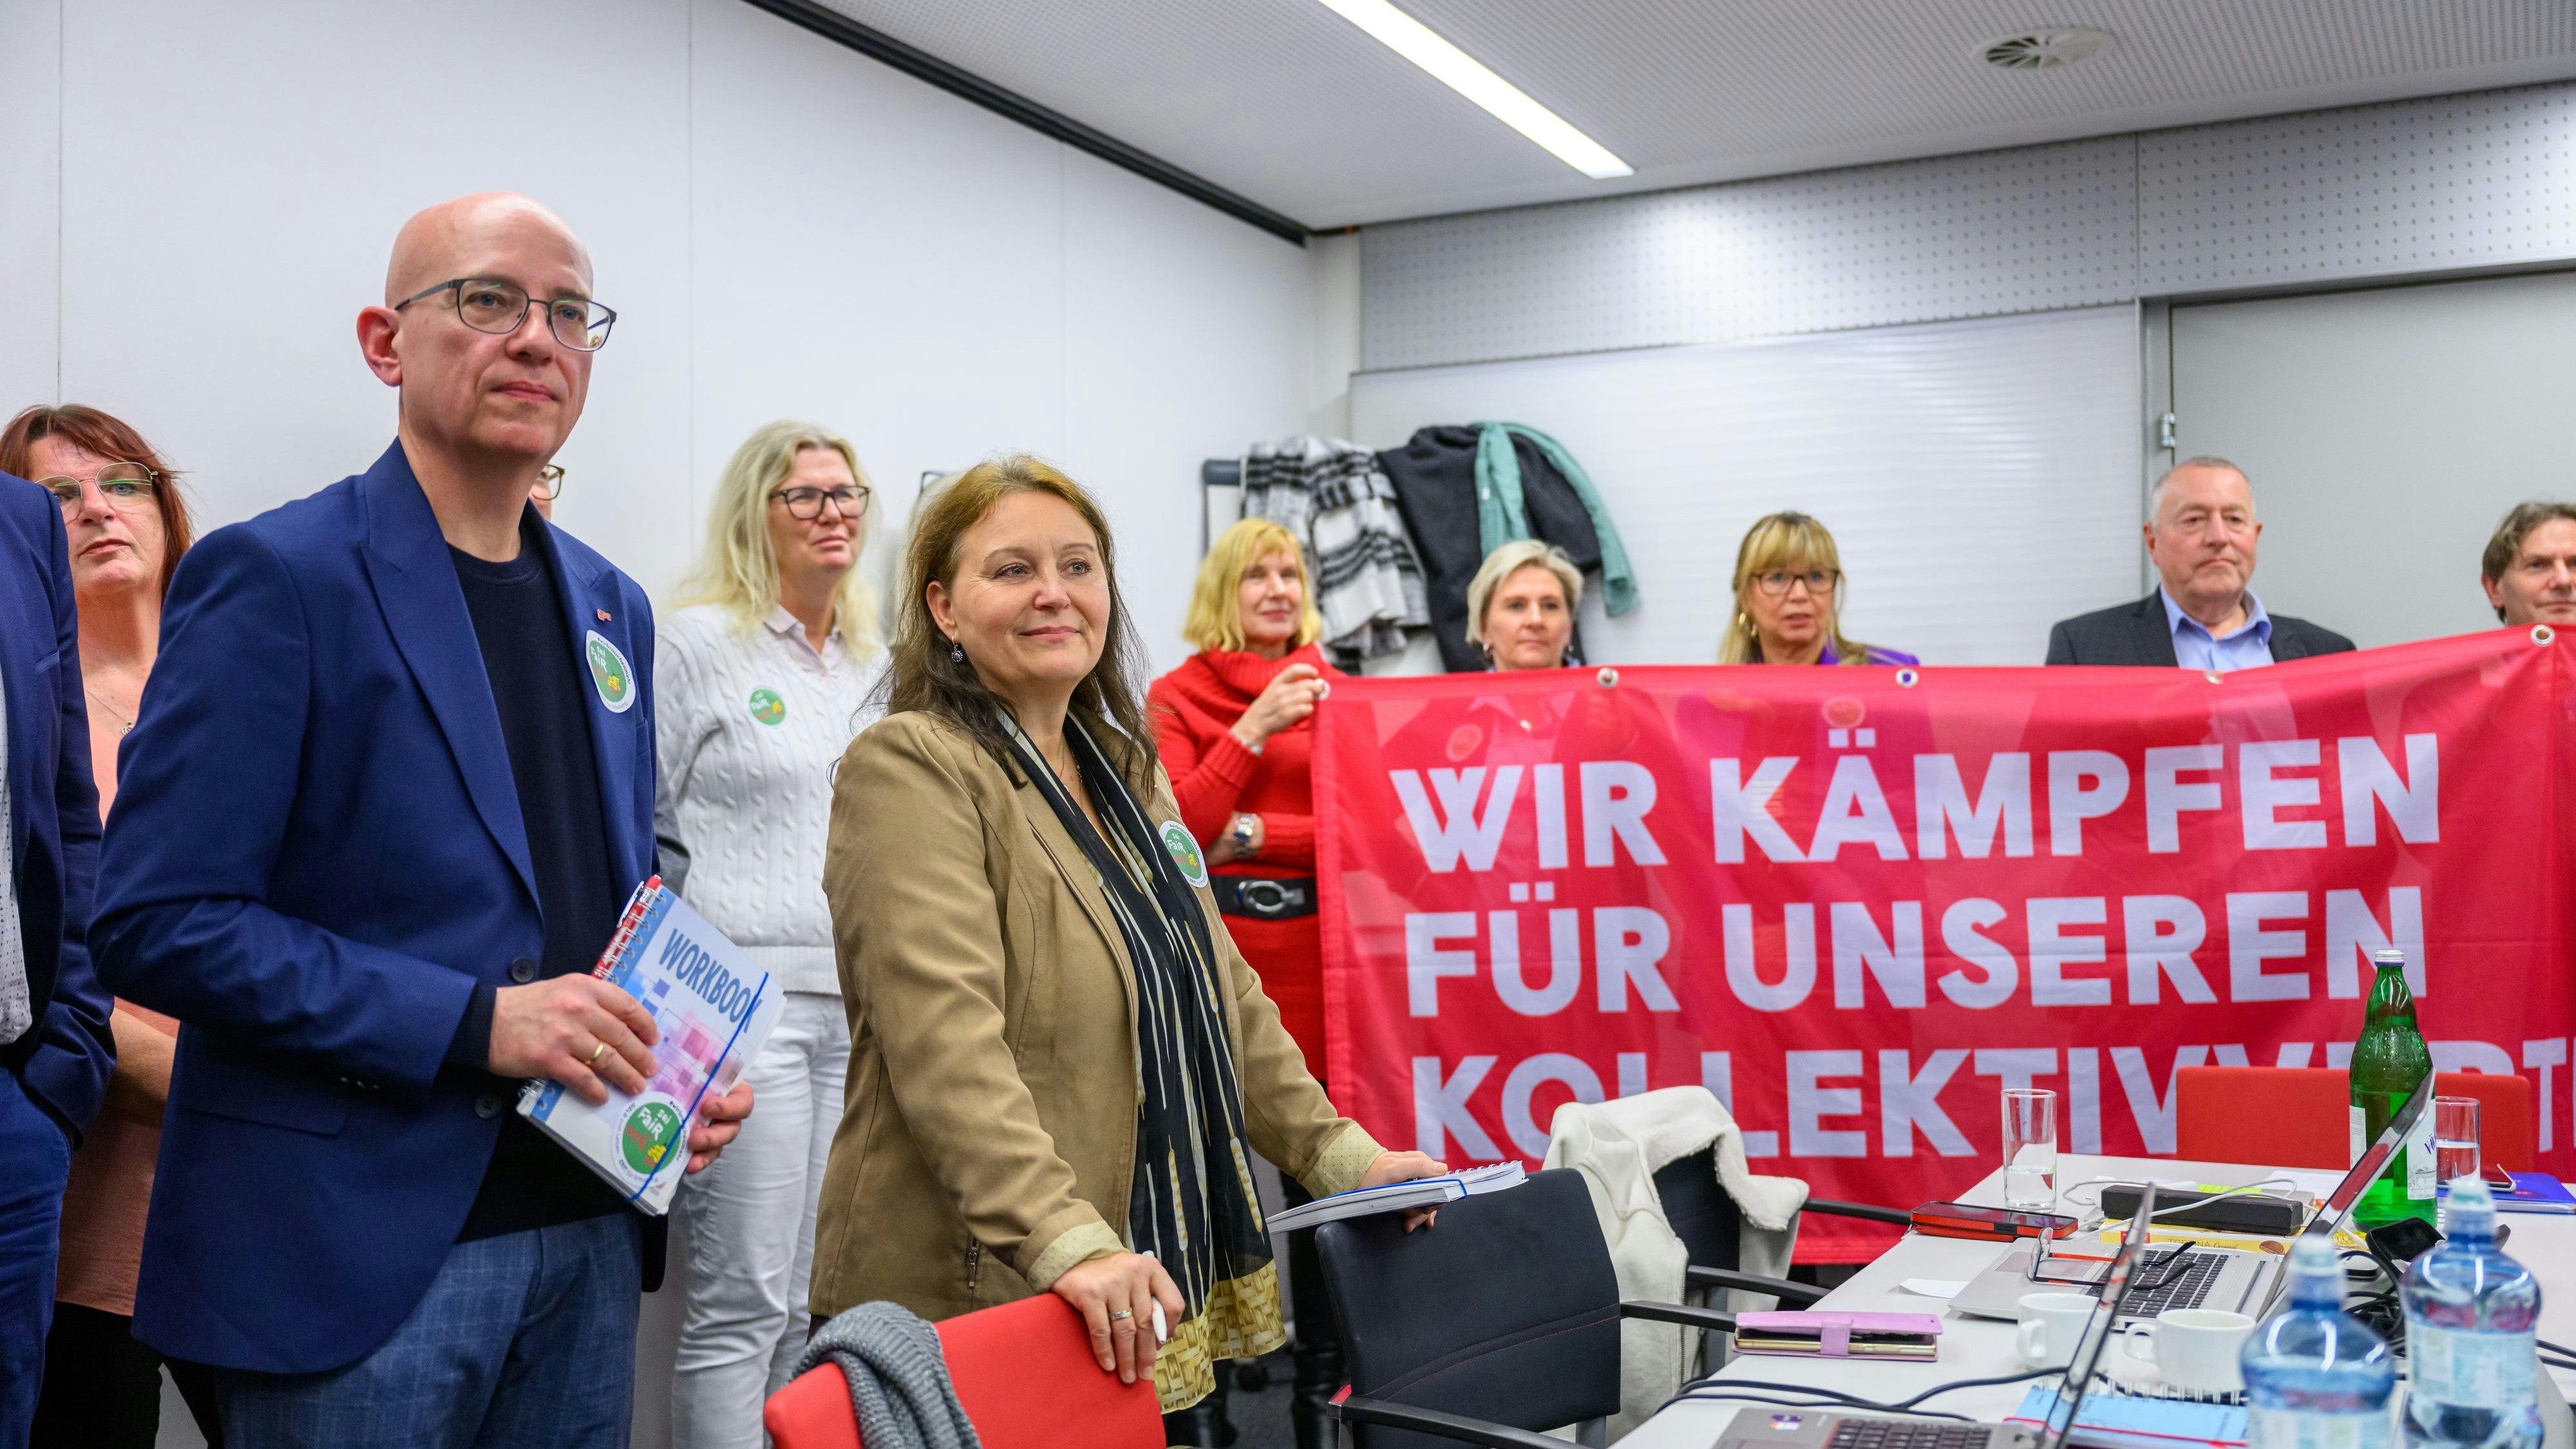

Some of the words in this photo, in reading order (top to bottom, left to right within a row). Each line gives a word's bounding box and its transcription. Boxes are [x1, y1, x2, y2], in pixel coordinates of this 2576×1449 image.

[1388, 761, 1667, 873] WIR
[1709, 728, 2440, 864] KÄMPFEN
[1405, 882, 1681, 1018] FÜR
[1721, 886, 2427, 1013] UNSEREN
[638, 1106, 664, 1141] FaiR
[657, 1108, 672, 1125] sei
[1411, 1036, 2576, 1162] KOLEKTIVT
